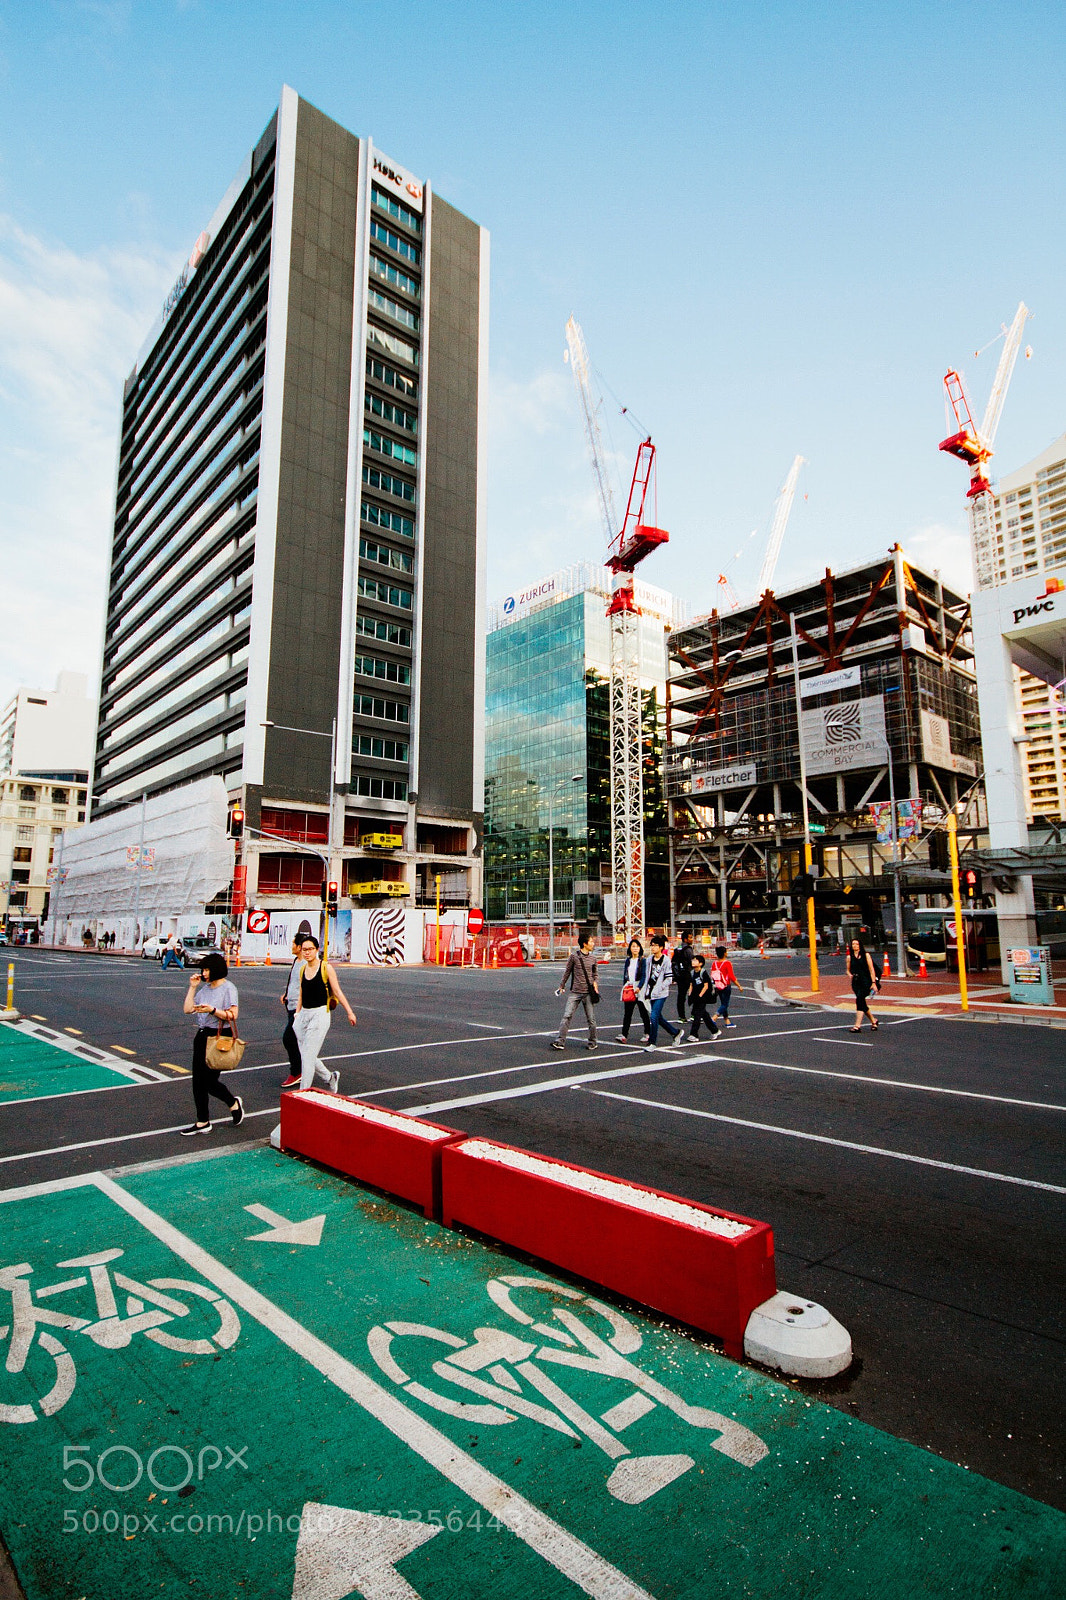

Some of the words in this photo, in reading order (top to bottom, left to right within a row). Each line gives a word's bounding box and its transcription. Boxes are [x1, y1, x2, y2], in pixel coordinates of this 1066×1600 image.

[373, 157, 403, 186] HSBC
[519, 579, 556, 604] ZURICH
[1012, 600, 1055, 625] pwc
[811, 740, 878, 760] COMMERCIAL
[834, 755, 854, 766] BAY
[705, 771, 753, 787] Fletcher
